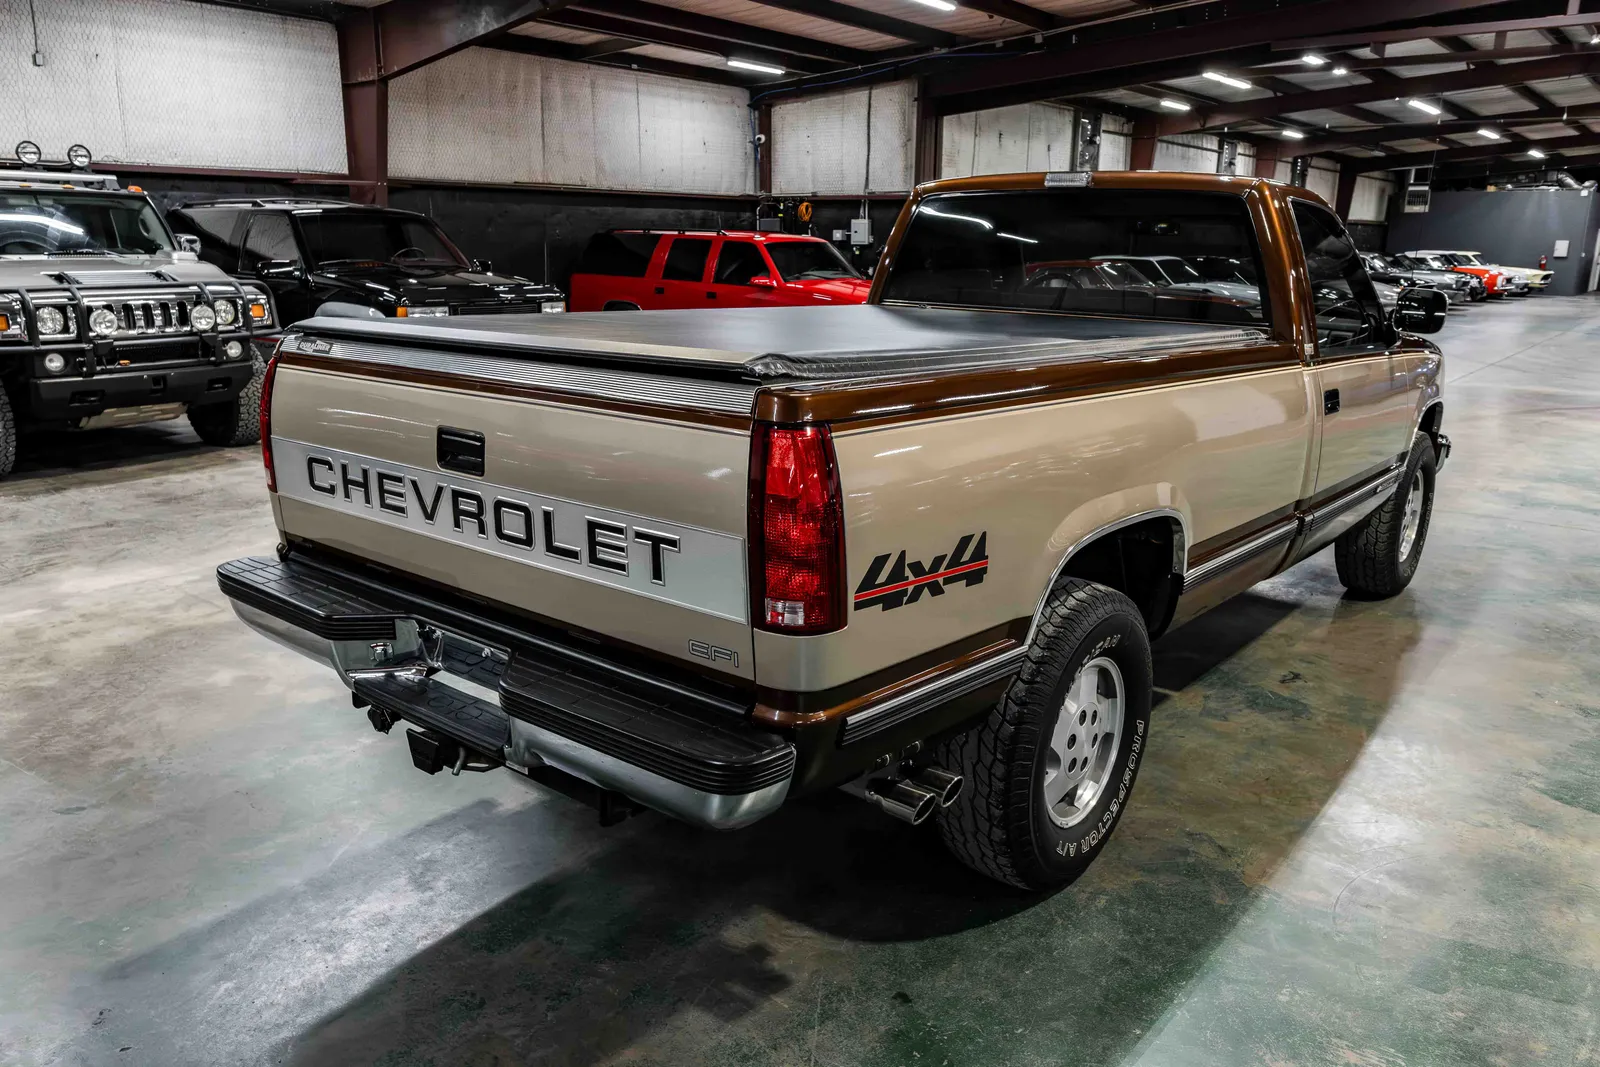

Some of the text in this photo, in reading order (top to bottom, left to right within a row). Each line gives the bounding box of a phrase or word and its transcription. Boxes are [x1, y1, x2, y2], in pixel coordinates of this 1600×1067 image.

[306, 453, 681, 587] CHEVROLET
[853, 530, 989, 612] 4x4
[688, 638, 739, 668] EFI
[1081, 719, 1145, 854] PROSPECTOR
[1056, 841, 1077, 857] A/T
